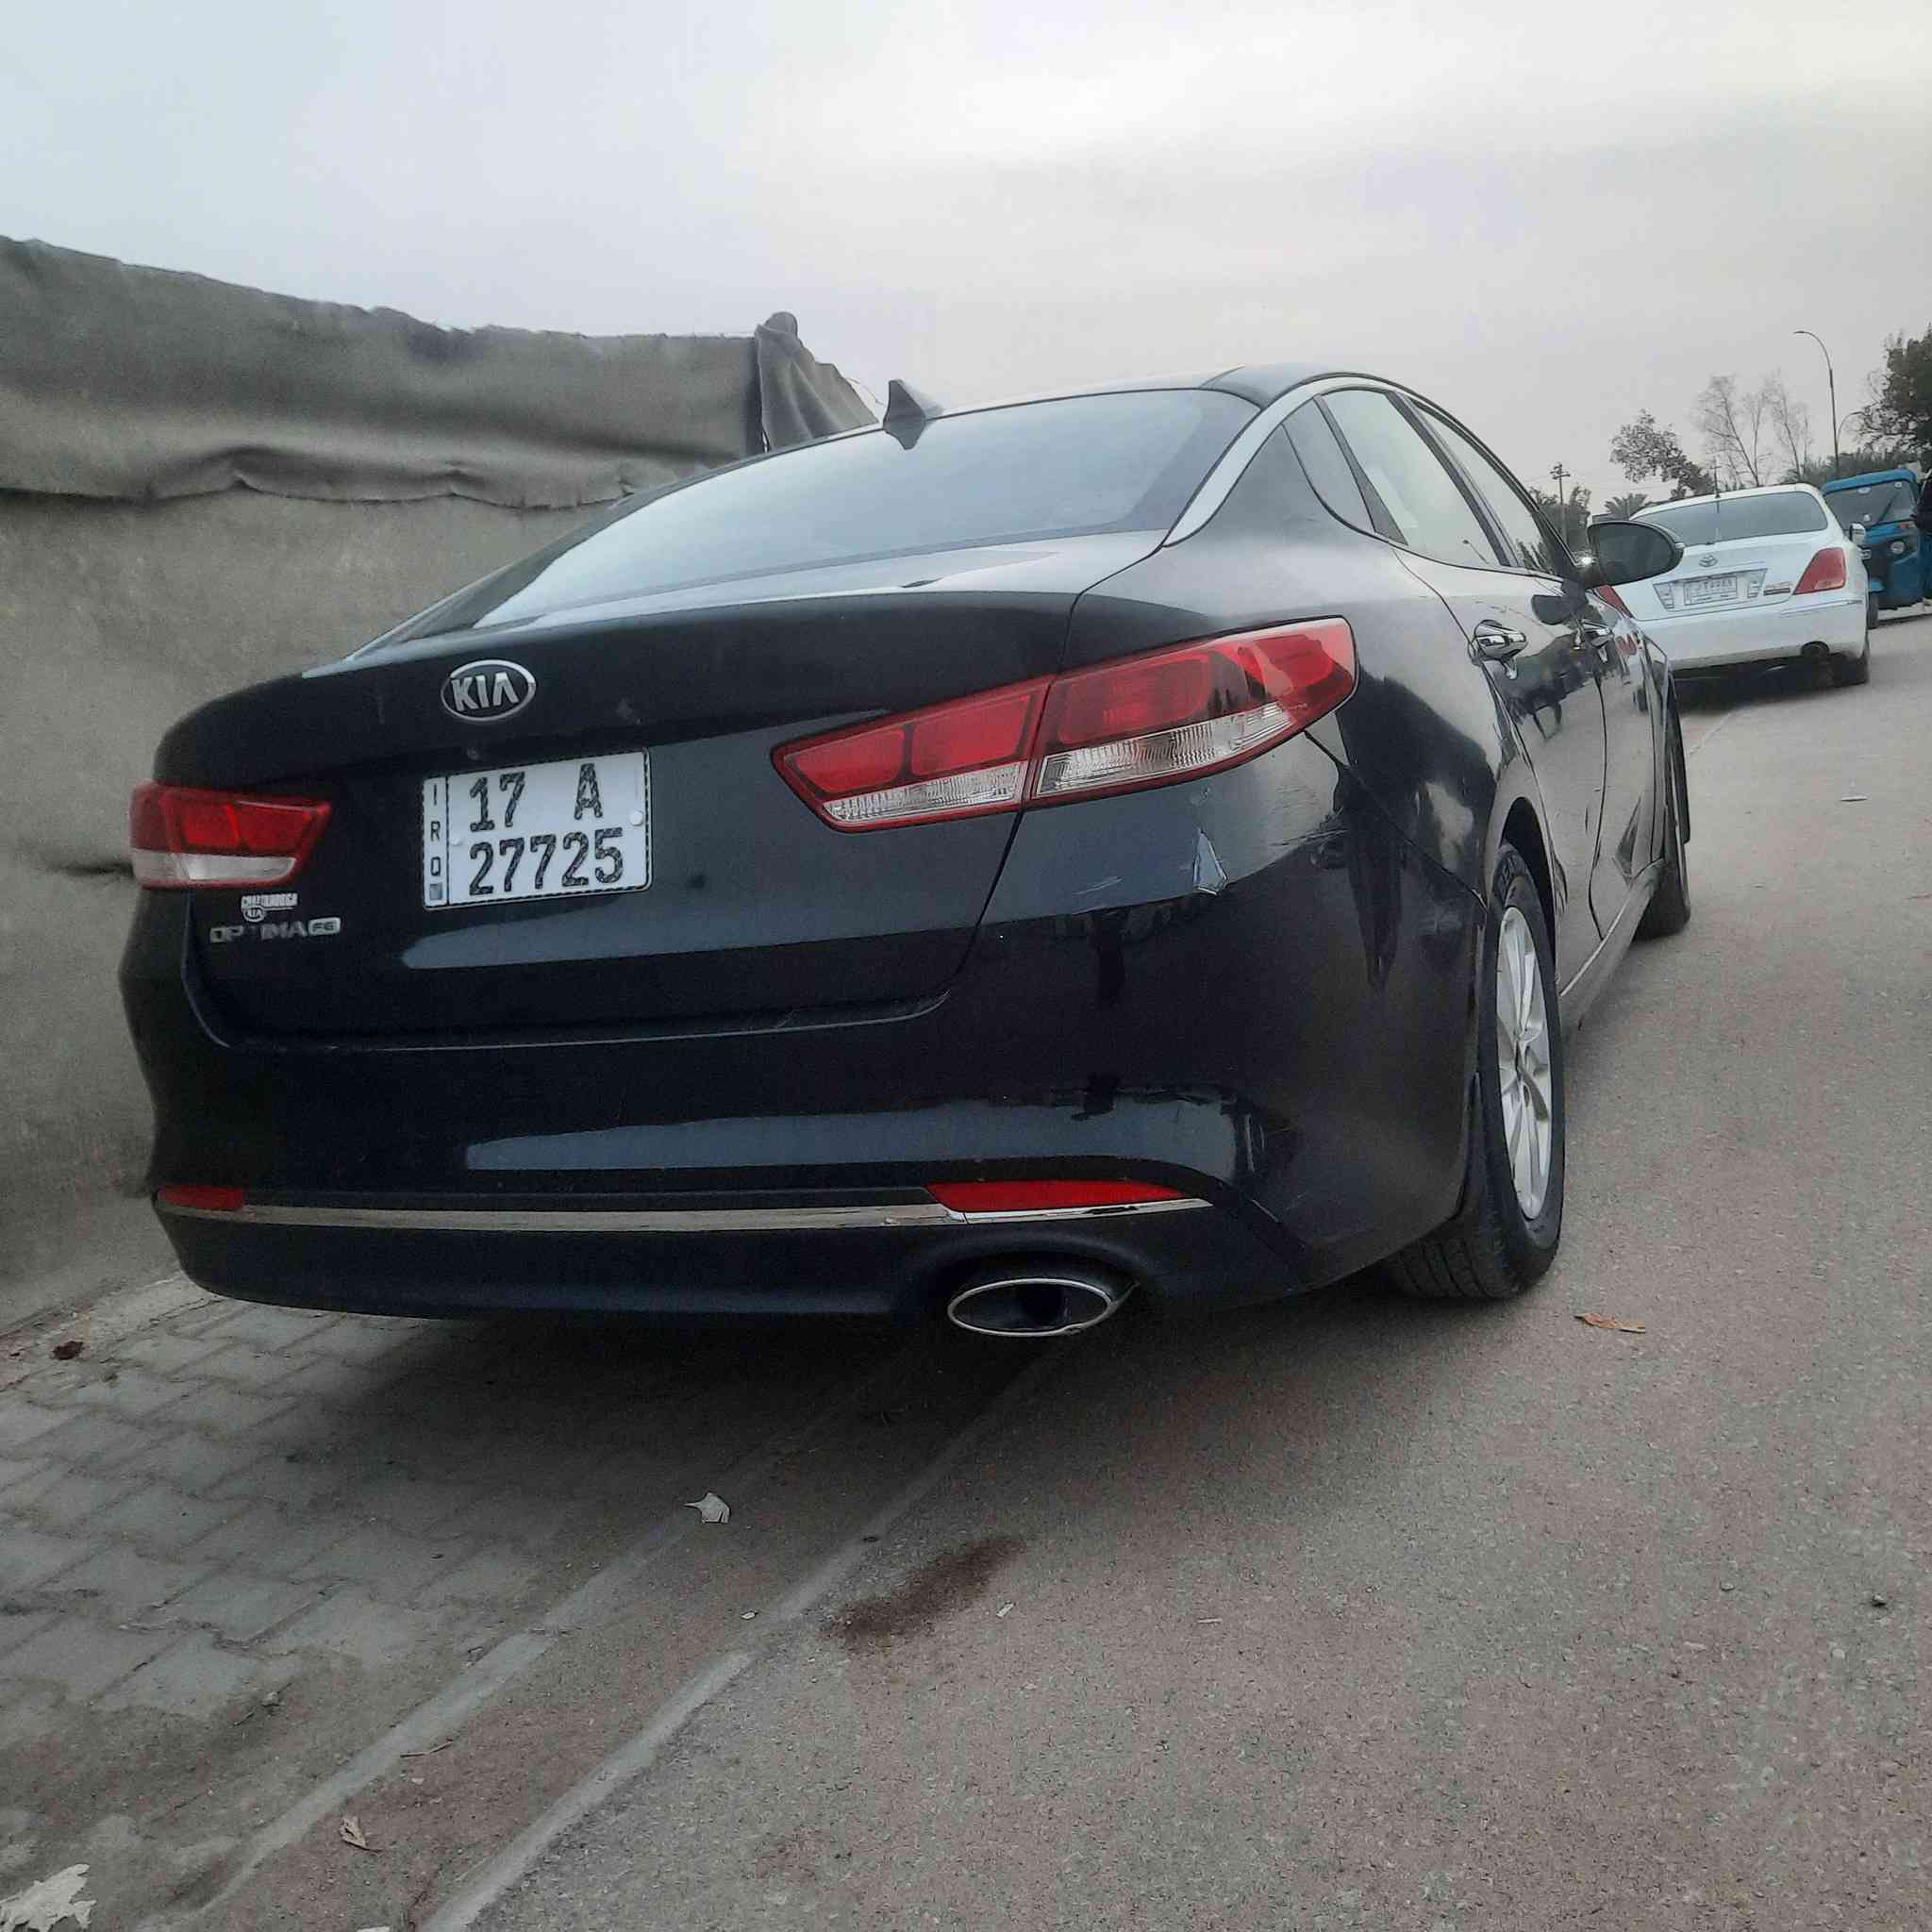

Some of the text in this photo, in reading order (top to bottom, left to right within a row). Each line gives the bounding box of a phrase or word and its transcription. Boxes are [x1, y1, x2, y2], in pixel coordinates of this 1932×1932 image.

[450, 672, 519, 712] KIA
[469, 762, 604, 832] 17 A
[468, 826, 624, 896] 27725
